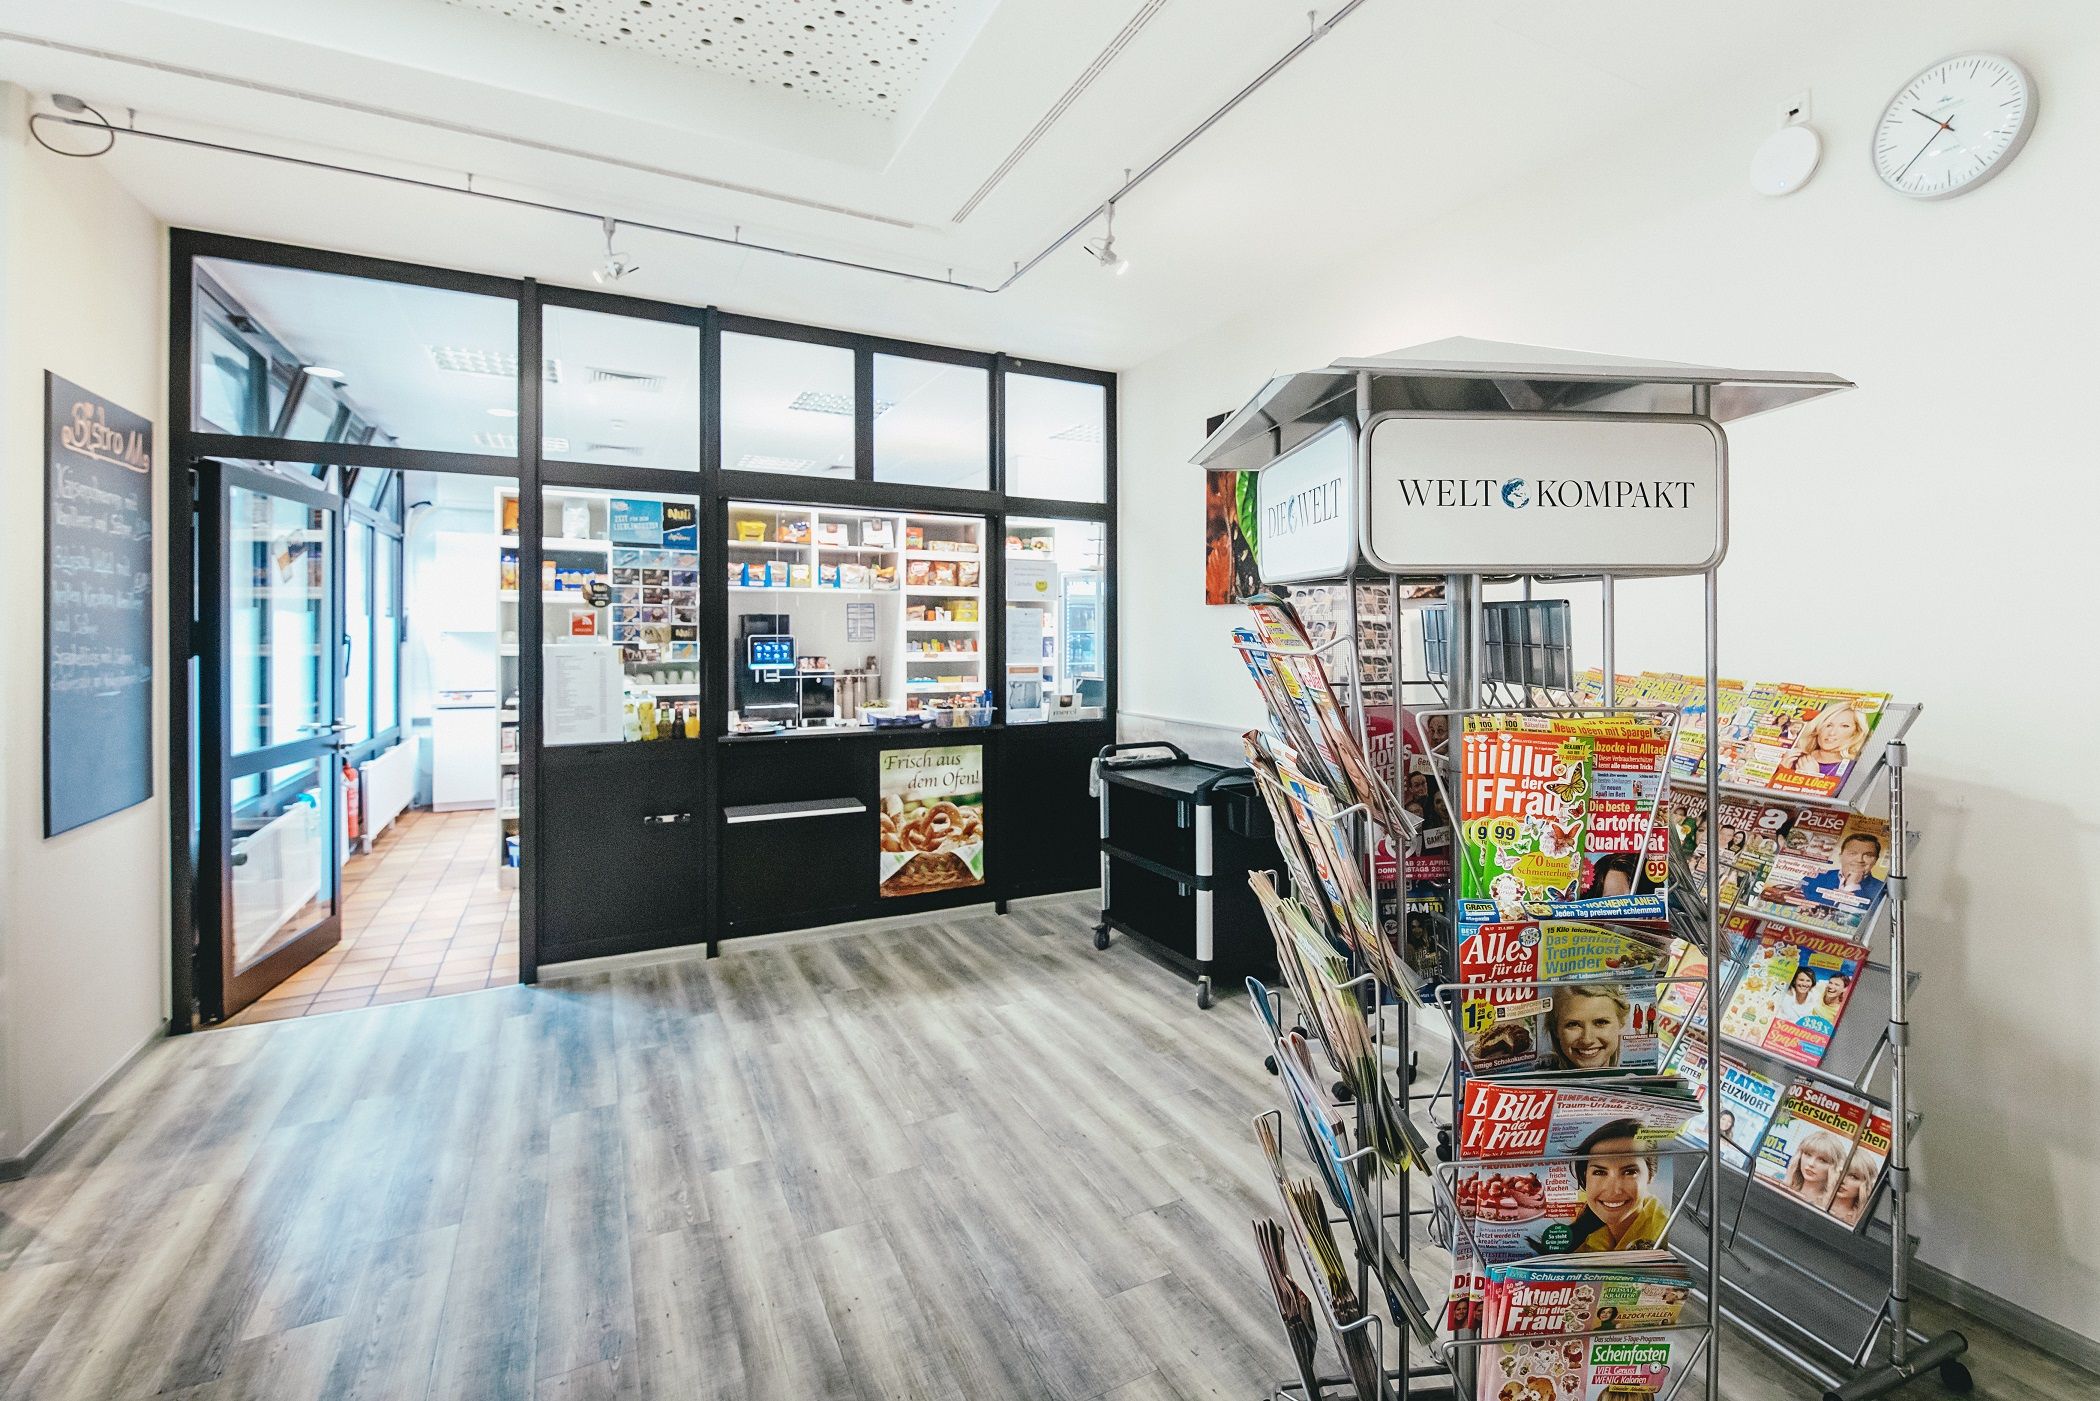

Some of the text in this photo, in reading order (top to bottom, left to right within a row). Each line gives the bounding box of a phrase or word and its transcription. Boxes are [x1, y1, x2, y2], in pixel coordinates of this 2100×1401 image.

[1398, 479, 1696, 509] WELT KOMPAKT
[1268, 477, 1342, 538] DIE WELT
[1505, 720, 1518, 728] 100
[1553, 723, 1576, 734] Neue
[1577, 725, 1603, 736] Ideen
[1605, 727, 1620, 736] mit
[1621, 727, 1653, 739] Spargel
[1627, 743, 1638, 753] im
[1639, 744, 1667, 756] Alltag!
[884, 750, 961, 770] Frisch aus
[1500, 743, 1553, 777] illu
[907, 768, 980, 794] dem Ofen!
[1521, 777, 1543, 789] der
[1775, 773, 1836, 790] ALLES LÜGE?
[1495, 778, 1560, 816] Frau
[1589, 801, 1605, 812] Die
[1606, 800, 1630, 812] beste
[1719, 804, 1758, 821] BESTE
[1586, 813, 1658, 831] Kartoffe-
[1794, 810, 1844, 830] Pause
[1495, 826, 1515, 840] 99
[1584, 833, 1665, 852] Quark-Dät
[1527, 855, 1544, 866] 70
[1648, 862, 1666, 876] 99
[1378, 866, 1430, 874] DONNSTAGS
[1517, 867, 1576, 880] Schmetterlinge
[1555, 909, 1575, 917] Jeden
[1576, 909, 1588, 917] Tag
[1590, 908, 1622, 918] preiswert
[1546, 935, 1568, 945] Das
[1783, 928, 1865, 961] Sommer
[1462, 933, 1533, 965] Alles
[1489, 961, 1533, 979] für die
[1546, 957, 1603, 974] Wunder
[1467, 974, 1534, 1003] Frau
[1494, 1054, 1535, 1066] Schokokuchen
[1680, 1064, 1702, 1079] GITTER
[1556, 1094, 1607, 1102] EINFACH
[1557, 1101, 1623, 1109] Traum-Urlaub
[1720, 1080, 1771, 1113] EUZWORT
[1804, 1089, 1840, 1112] Seiten
[1488, 1092, 1554, 1121] Bild
[1511, 1120, 1531, 1131] der
[1484, 1123, 1545, 1150] Frau
[1530, 1272, 1564, 1281] Schluss
[1566, 1272, 1580, 1281] mit
[1582, 1273, 1634, 1282] Schmerzen
[1511, 1288, 1571, 1306] aktuell
[1506, 1306, 1564, 1332] Frau
[1617, 1312, 1673, 1320] ABZOCK-FALLEN
[1623, 1336, 1666, 1344] 5-Tage-Programm
[1594, 1345, 1667, 1366] Scheinfasten
[1613, 1366, 1635, 1374] Genuss
[1594, 1375, 1647, 1384] WENIG Kalorien
